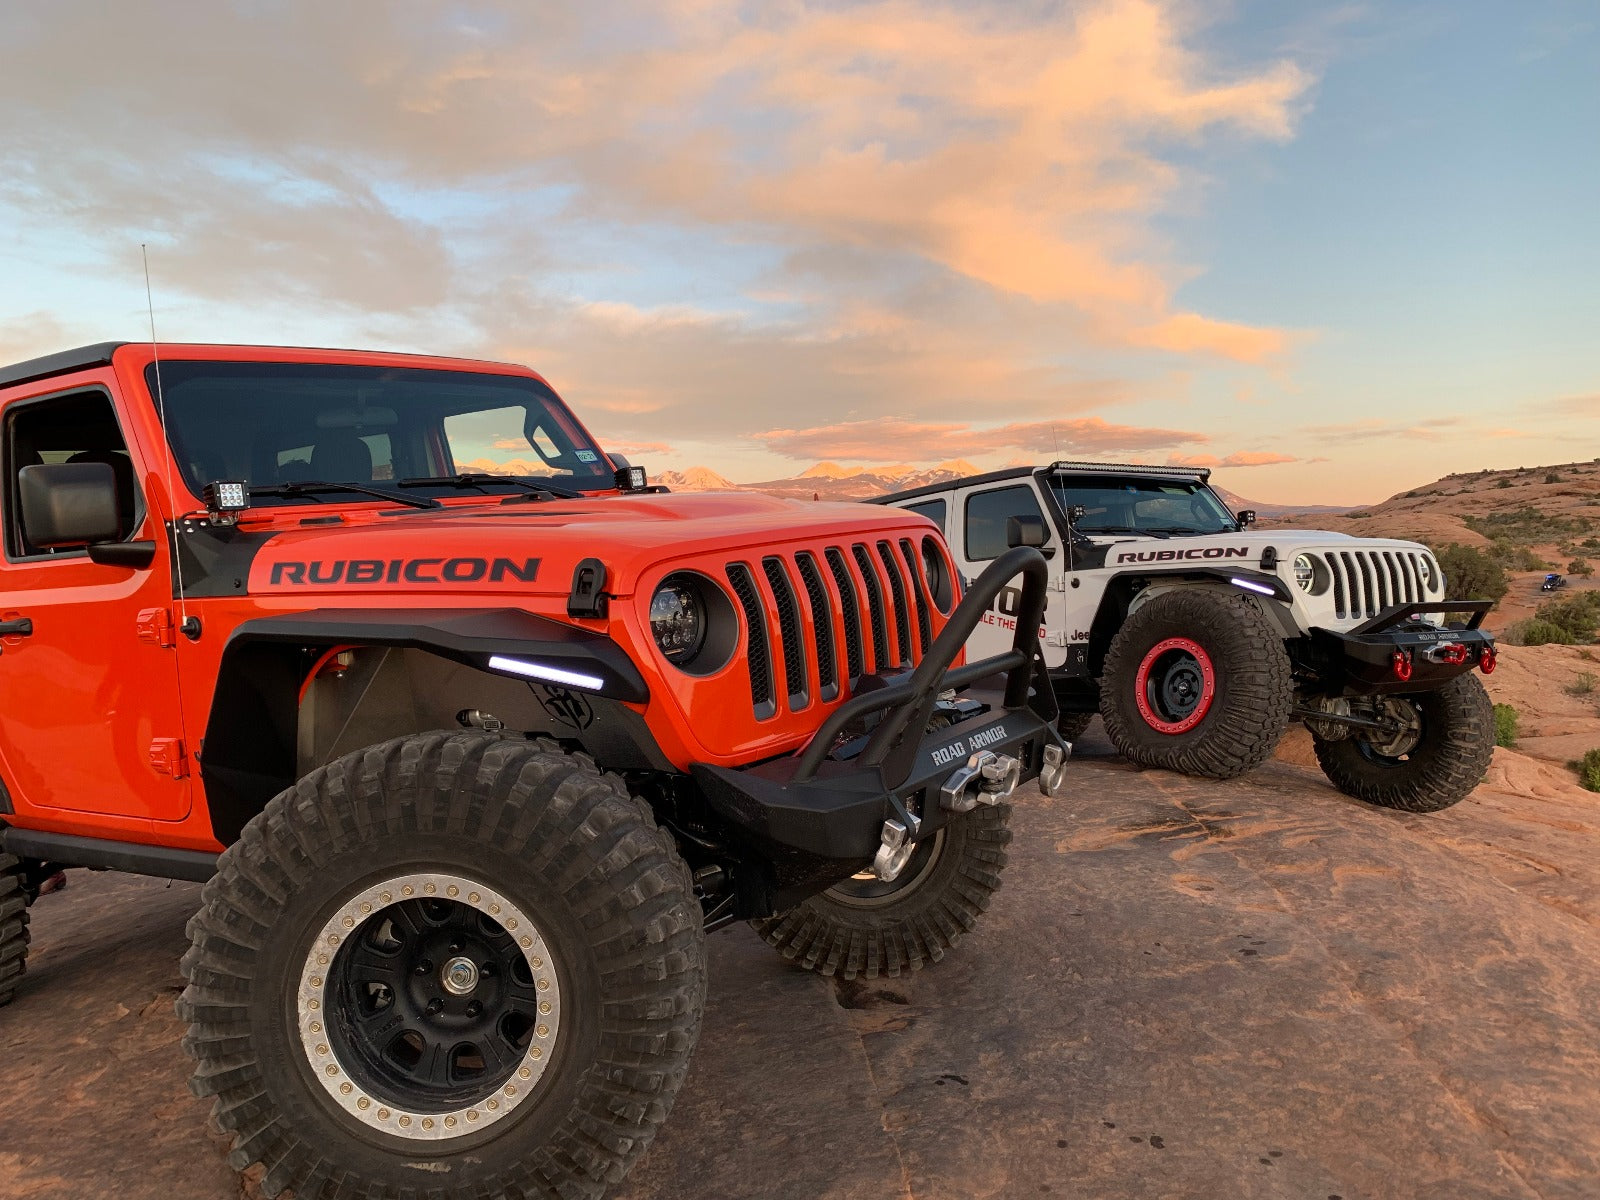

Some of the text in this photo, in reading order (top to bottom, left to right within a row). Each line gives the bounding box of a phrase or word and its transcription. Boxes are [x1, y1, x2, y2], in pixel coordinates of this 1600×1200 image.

[1117, 547, 1249, 563] RUBICON
[270, 557, 543, 585] RUBICON
[997, 617, 1016, 631] THE
[1070, 629, 1090, 641] Jee
[931, 725, 1007, 766] ROAD ARMOR
